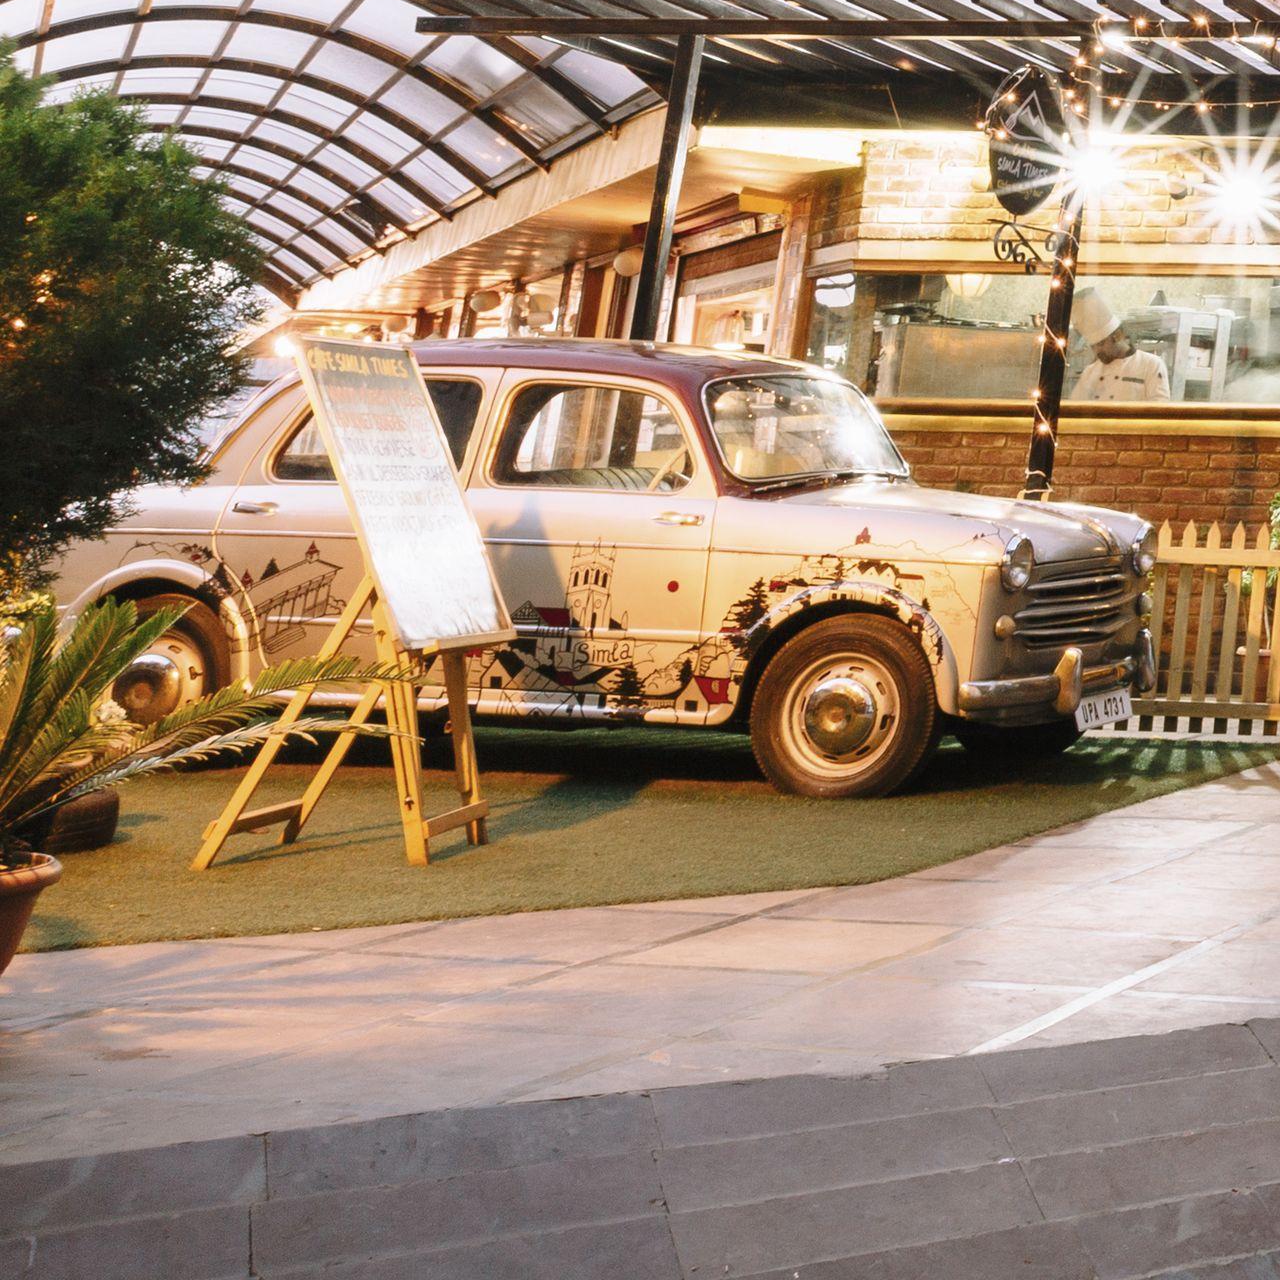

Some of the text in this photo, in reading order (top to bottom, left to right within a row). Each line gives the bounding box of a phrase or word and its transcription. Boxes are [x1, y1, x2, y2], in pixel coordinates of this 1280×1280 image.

[337, 353, 370, 376] SIMLA
[370, 357, 409, 378] TIMES
[574, 641, 633, 664] Simla
[1081, 696, 1125, 723] UPA 4731
